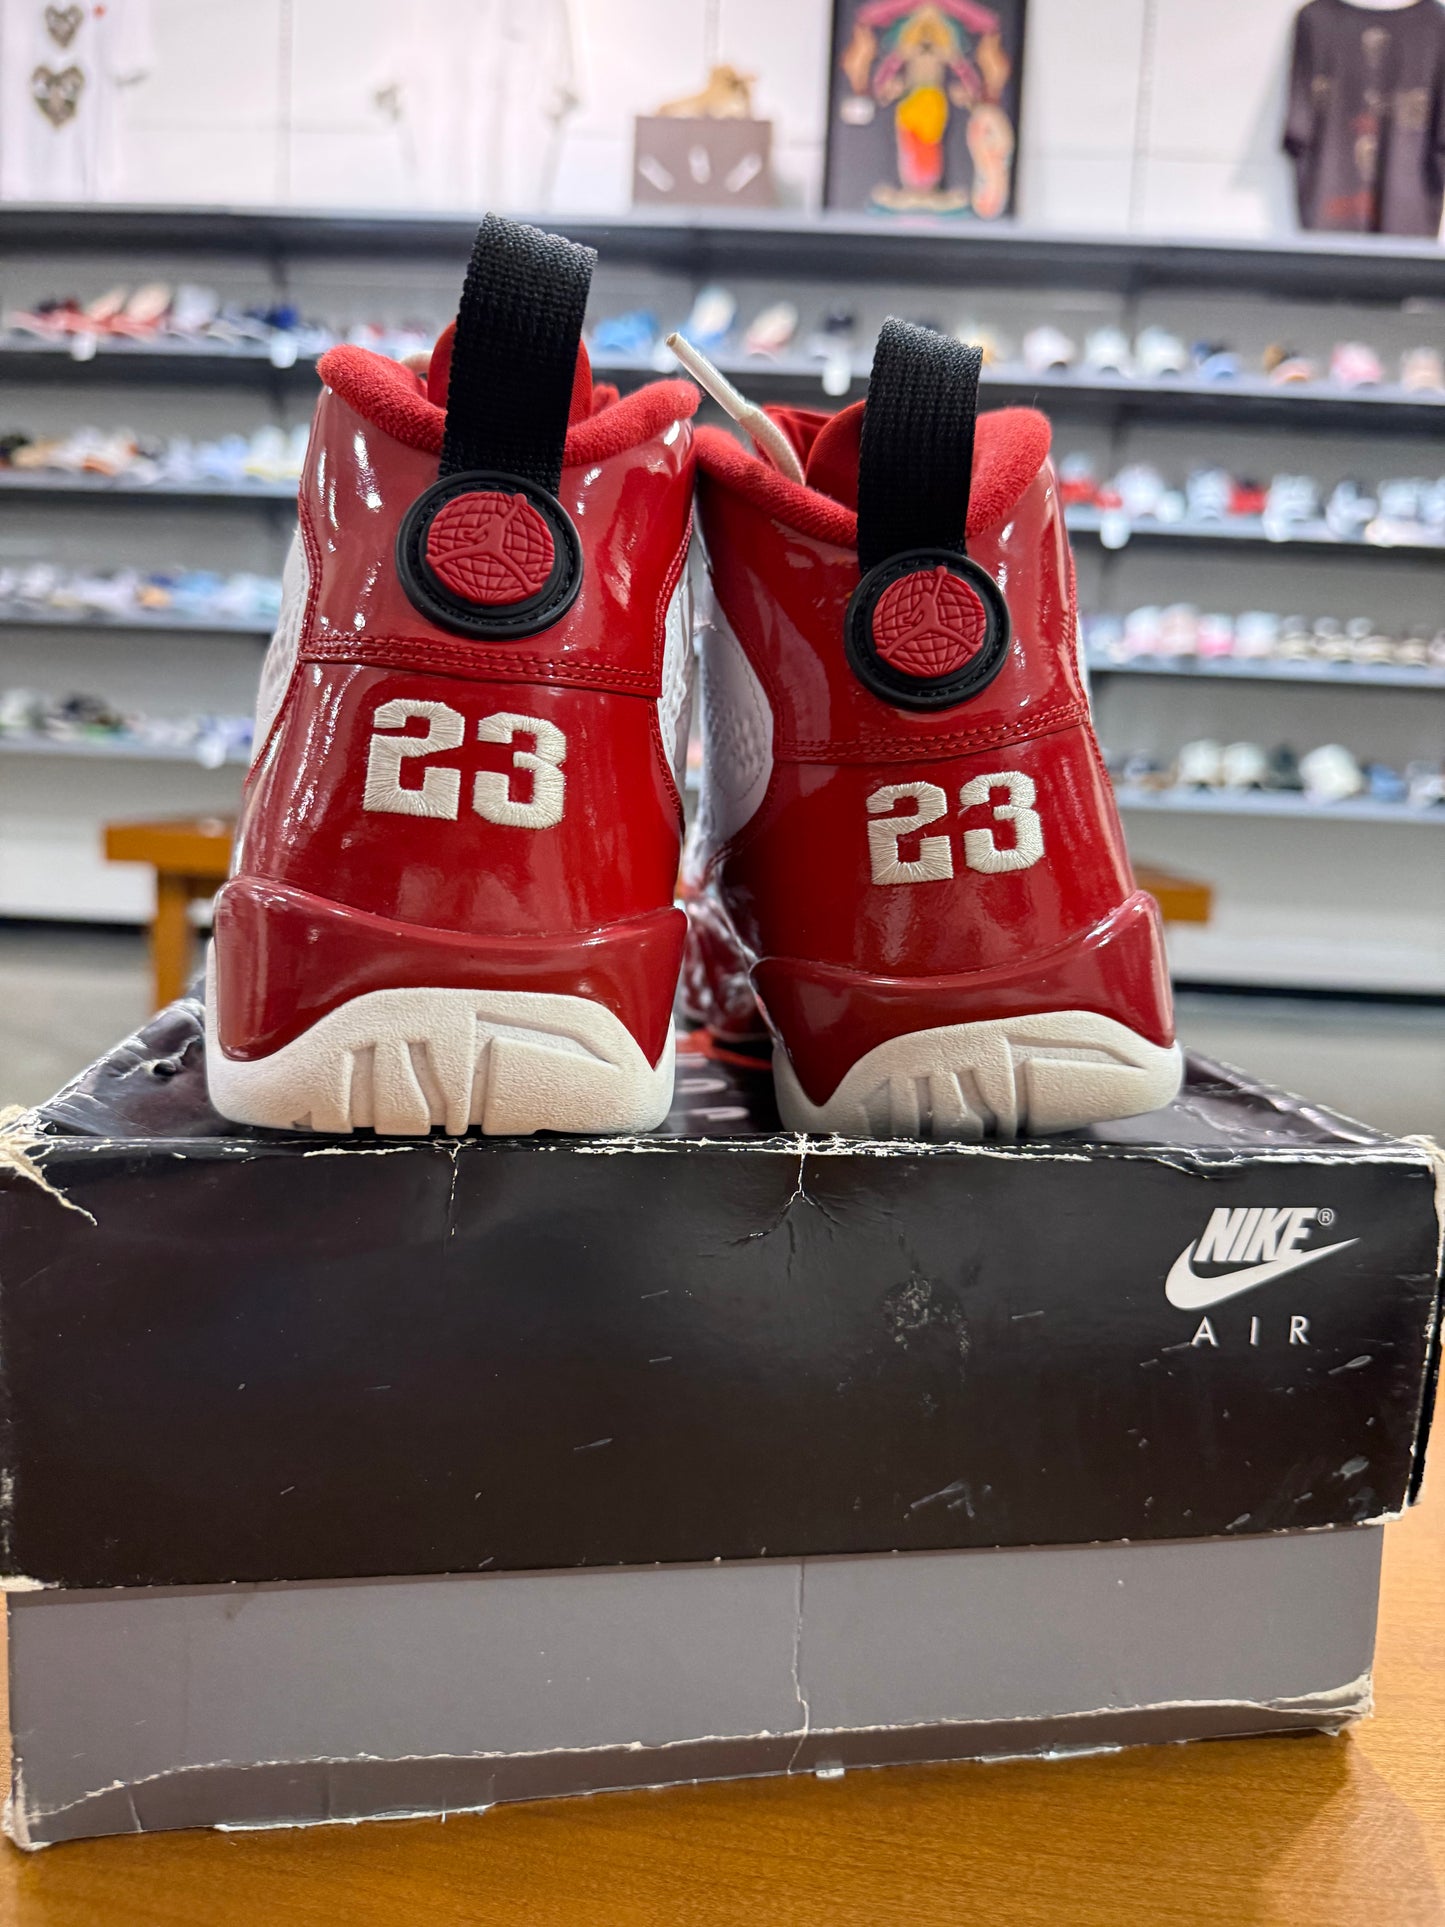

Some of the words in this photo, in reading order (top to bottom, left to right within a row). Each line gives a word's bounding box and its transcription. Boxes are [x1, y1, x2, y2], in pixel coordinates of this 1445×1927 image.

[362, 698, 567, 830] 23
[866, 770, 1045, 886] 23
[1191, 1315, 1310, 1347] AIR
